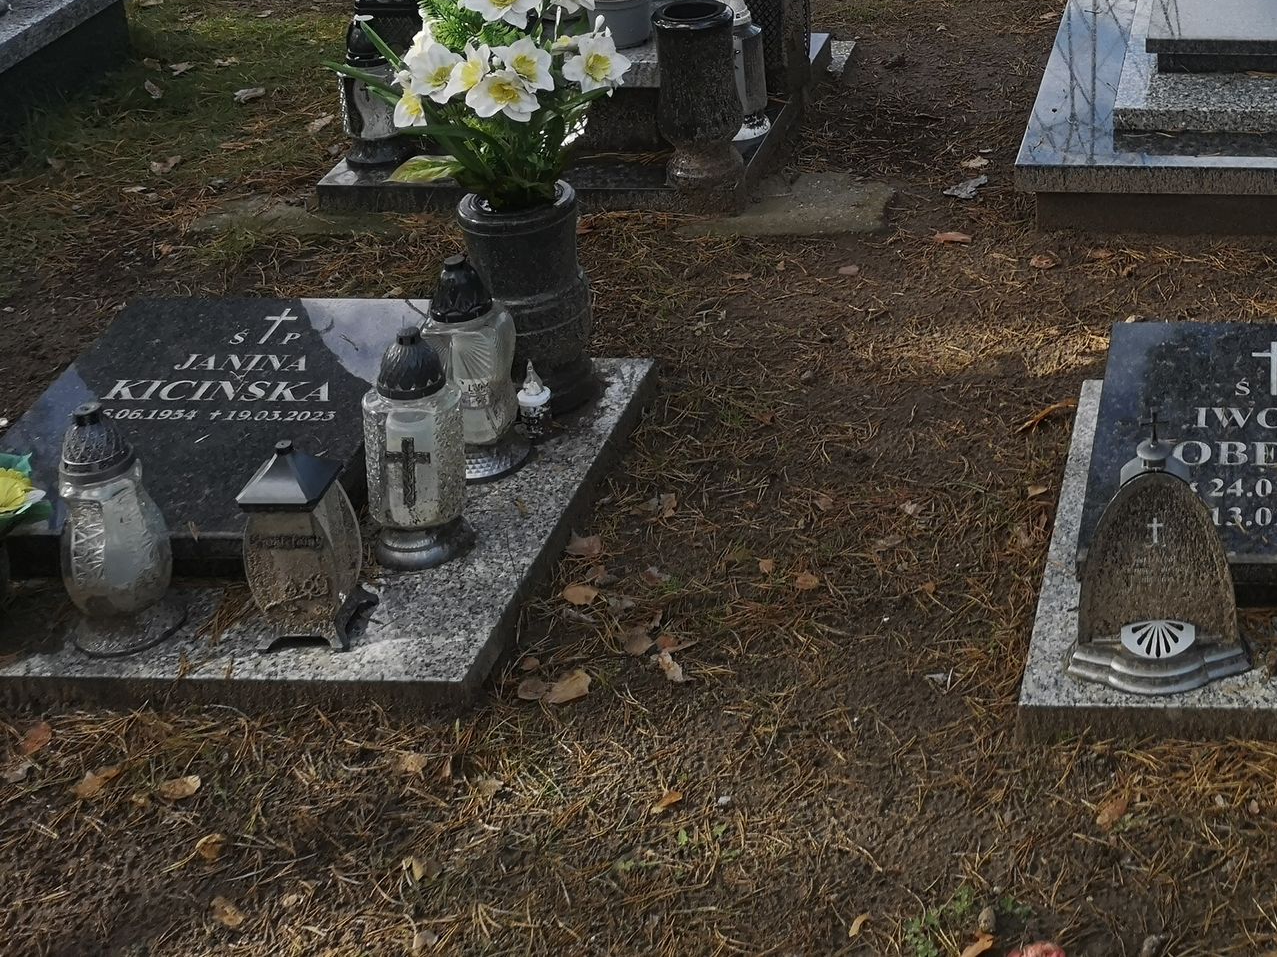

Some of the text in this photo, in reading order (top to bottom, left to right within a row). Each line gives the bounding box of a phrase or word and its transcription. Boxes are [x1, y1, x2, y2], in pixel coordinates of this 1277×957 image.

[280, 332, 302, 345] P
[173, 354, 308, 372] JANINA
[1235, 377, 1250, 396] Ś
[224, 410, 337, 422] 19.03.2023
